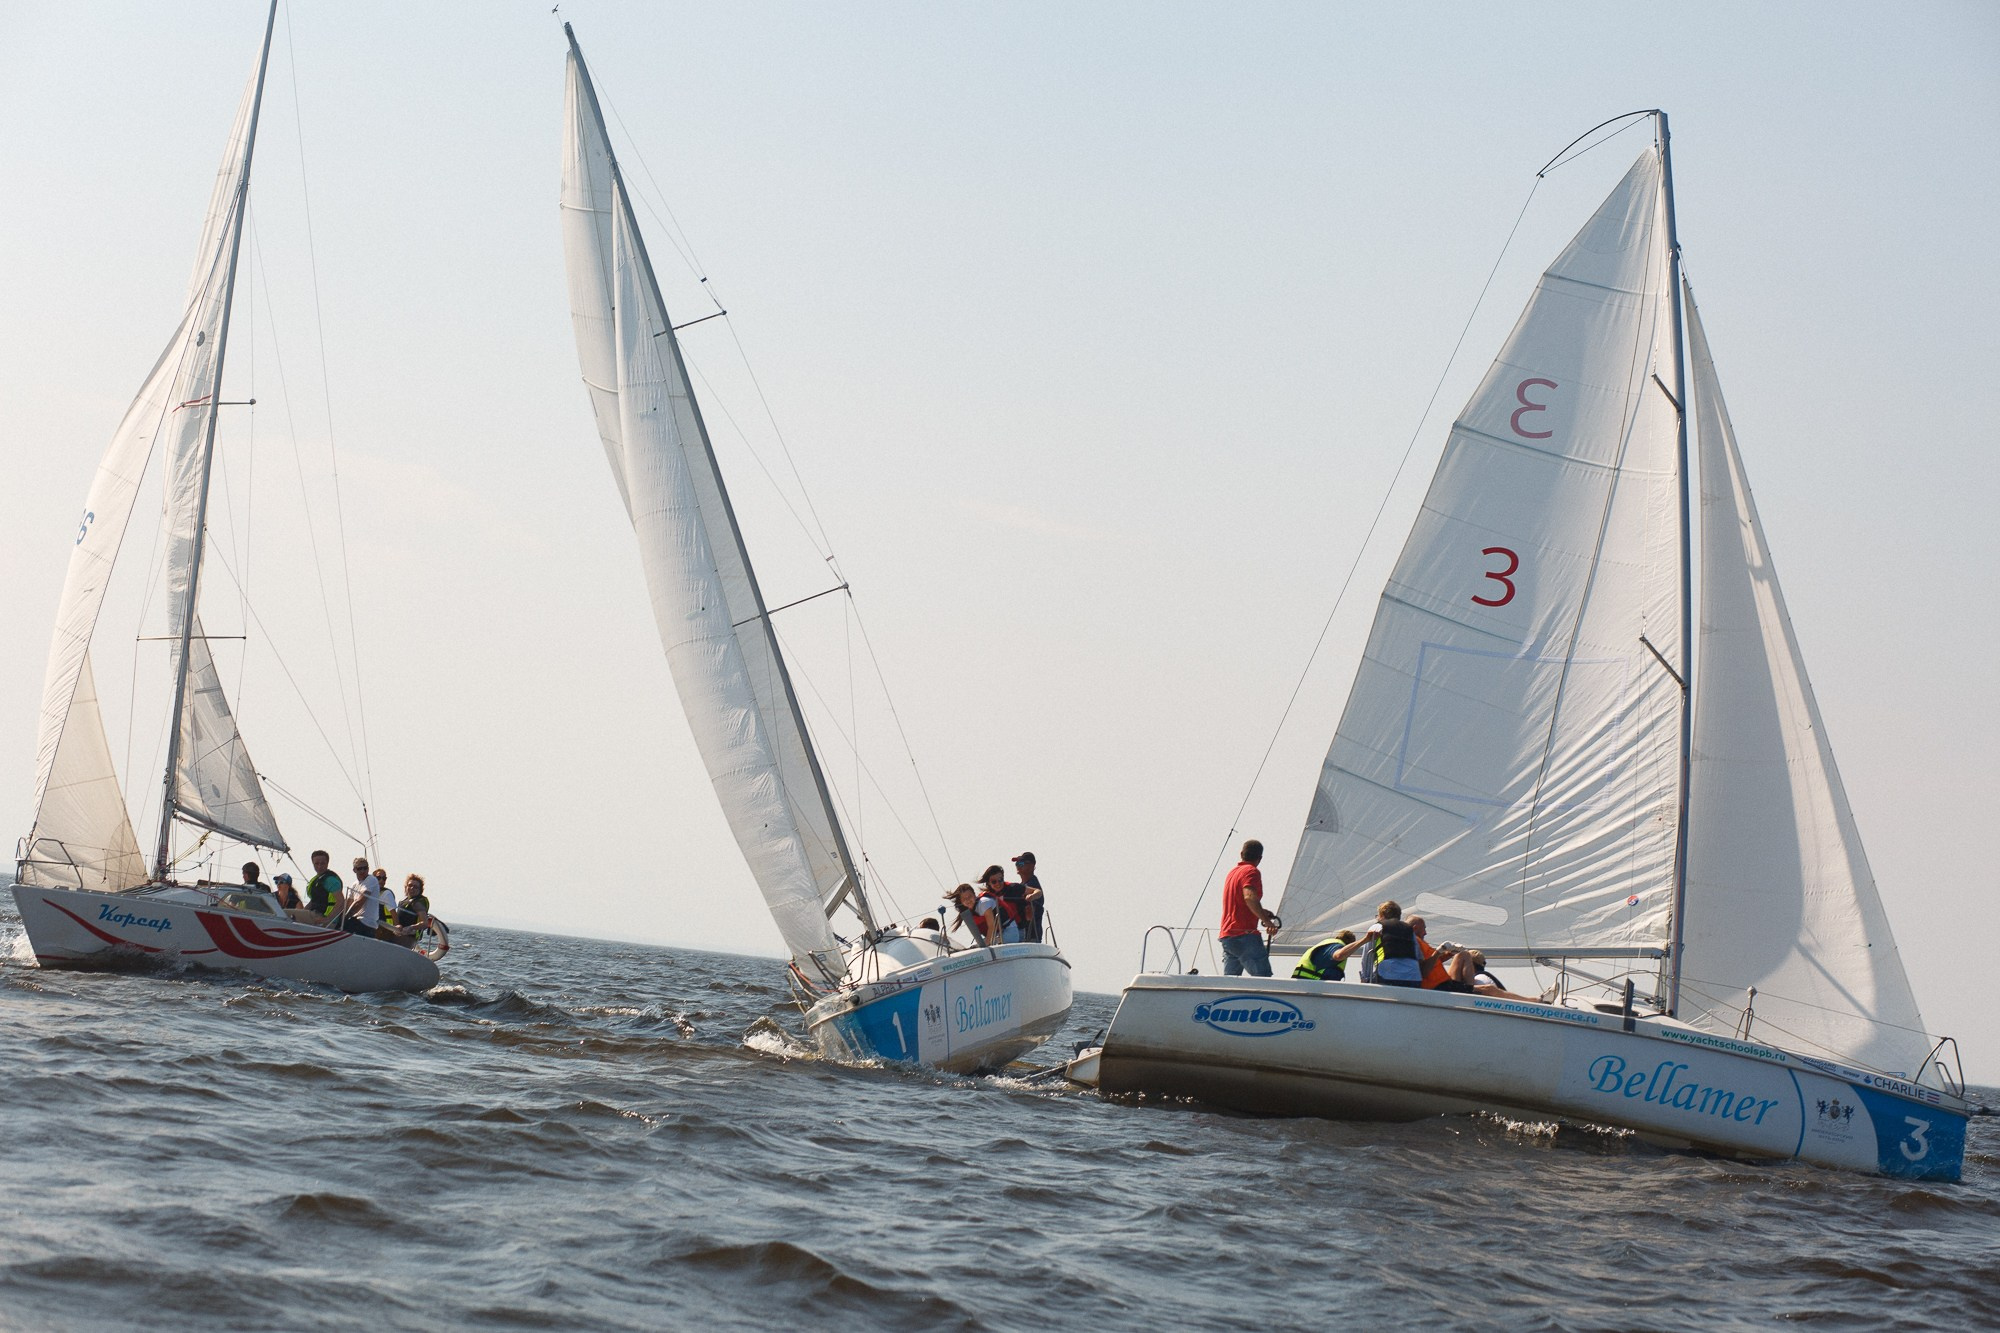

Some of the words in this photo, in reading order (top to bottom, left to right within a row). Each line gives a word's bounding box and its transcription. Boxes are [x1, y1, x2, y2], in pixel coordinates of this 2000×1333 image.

[1471, 546, 1519, 607] 3
[99, 904, 172, 932] Корсар
[955, 985, 1012, 1033] Bellamer
[1194, 1004, 1297, 1023] Santer
[1474, 1000, 1598, 1024] www.monotyperace.ru
[892, 1011, 906, 1053] 1
[1661, 1029, 1786, 1062] www.yachtschoolspb.ru
[1588, 1055, 1778, 1125] Bellamer
[1874, 1077, 1925, 1100] CHARLIE
[1900, 1116, 1930, 1161] 3
